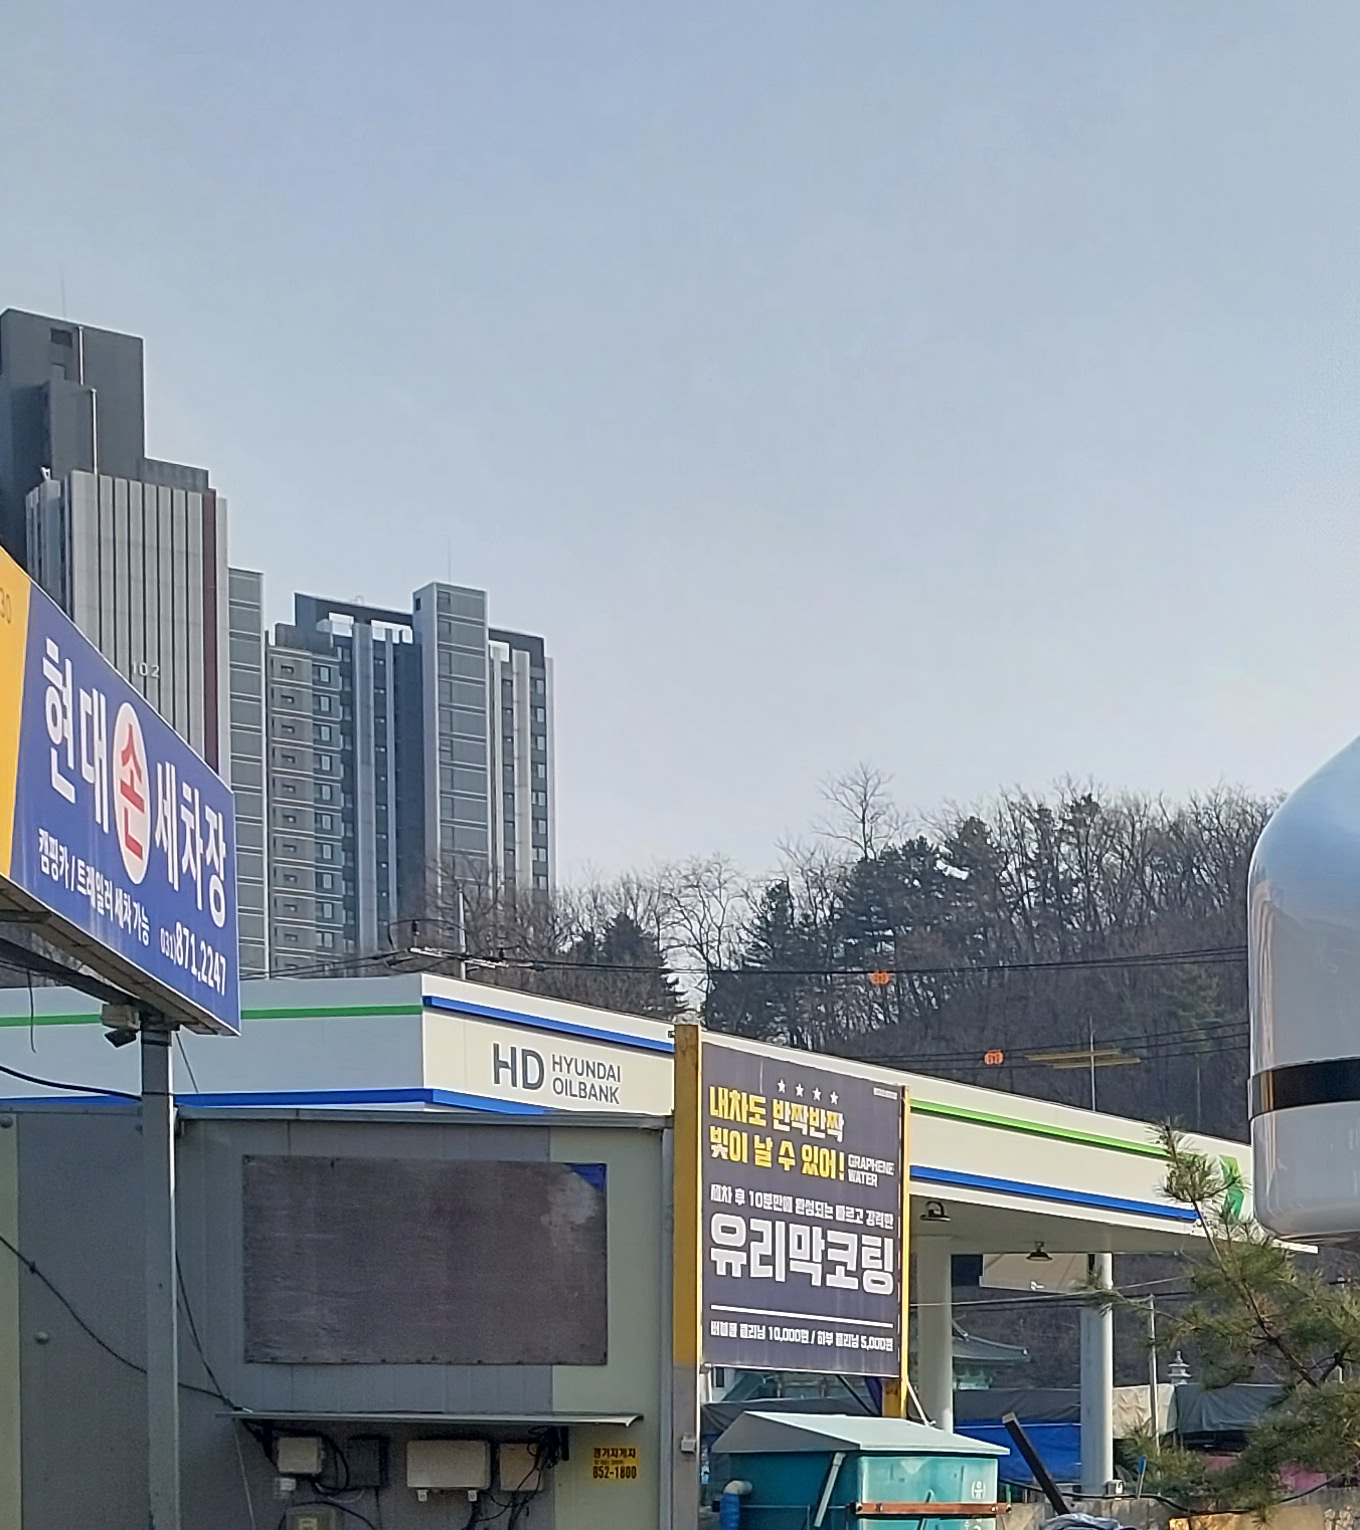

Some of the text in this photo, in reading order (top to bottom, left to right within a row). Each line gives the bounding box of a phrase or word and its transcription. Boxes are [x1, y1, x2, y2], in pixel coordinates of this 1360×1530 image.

[133, 661, 160, 678] 102
[38, 828, 70, 889] 캠핑카
[77, 859, 114, 921] 트레일러
[133, 902, 150, 946] 가능
[493, 1042, 621, 1090] HD HYUNDAI
[552, 1077, 620, 1105] OILBANK
[709, 1085, 845, 1143] 내차도 반짝반짝
[709, 1125, 748, 1163] 빛이
[753, 1134, 773, 1168] 날
[777, 1140, 796, 1171] 수
[848, 1153, 895, 1176] GRAPHENE
[848, 1168, 878, 1188] WATER
[710, 1183, 732, 1204] 세차
[735, 1187, 746, 1206] 후
[749, 1189, 793, 1214] 10분만에
[795, 1197, 833, 1220] 완성되는
[710, 1213, 894, 1295] 유리막코팅
[739, 1323, 766, 1340] 클리닝
[768, 1326, 809, 1344] 10,000원
[836, 1332, 859, 1349] 클리닝
[592, 1465, 637, 1479] 852-1800
